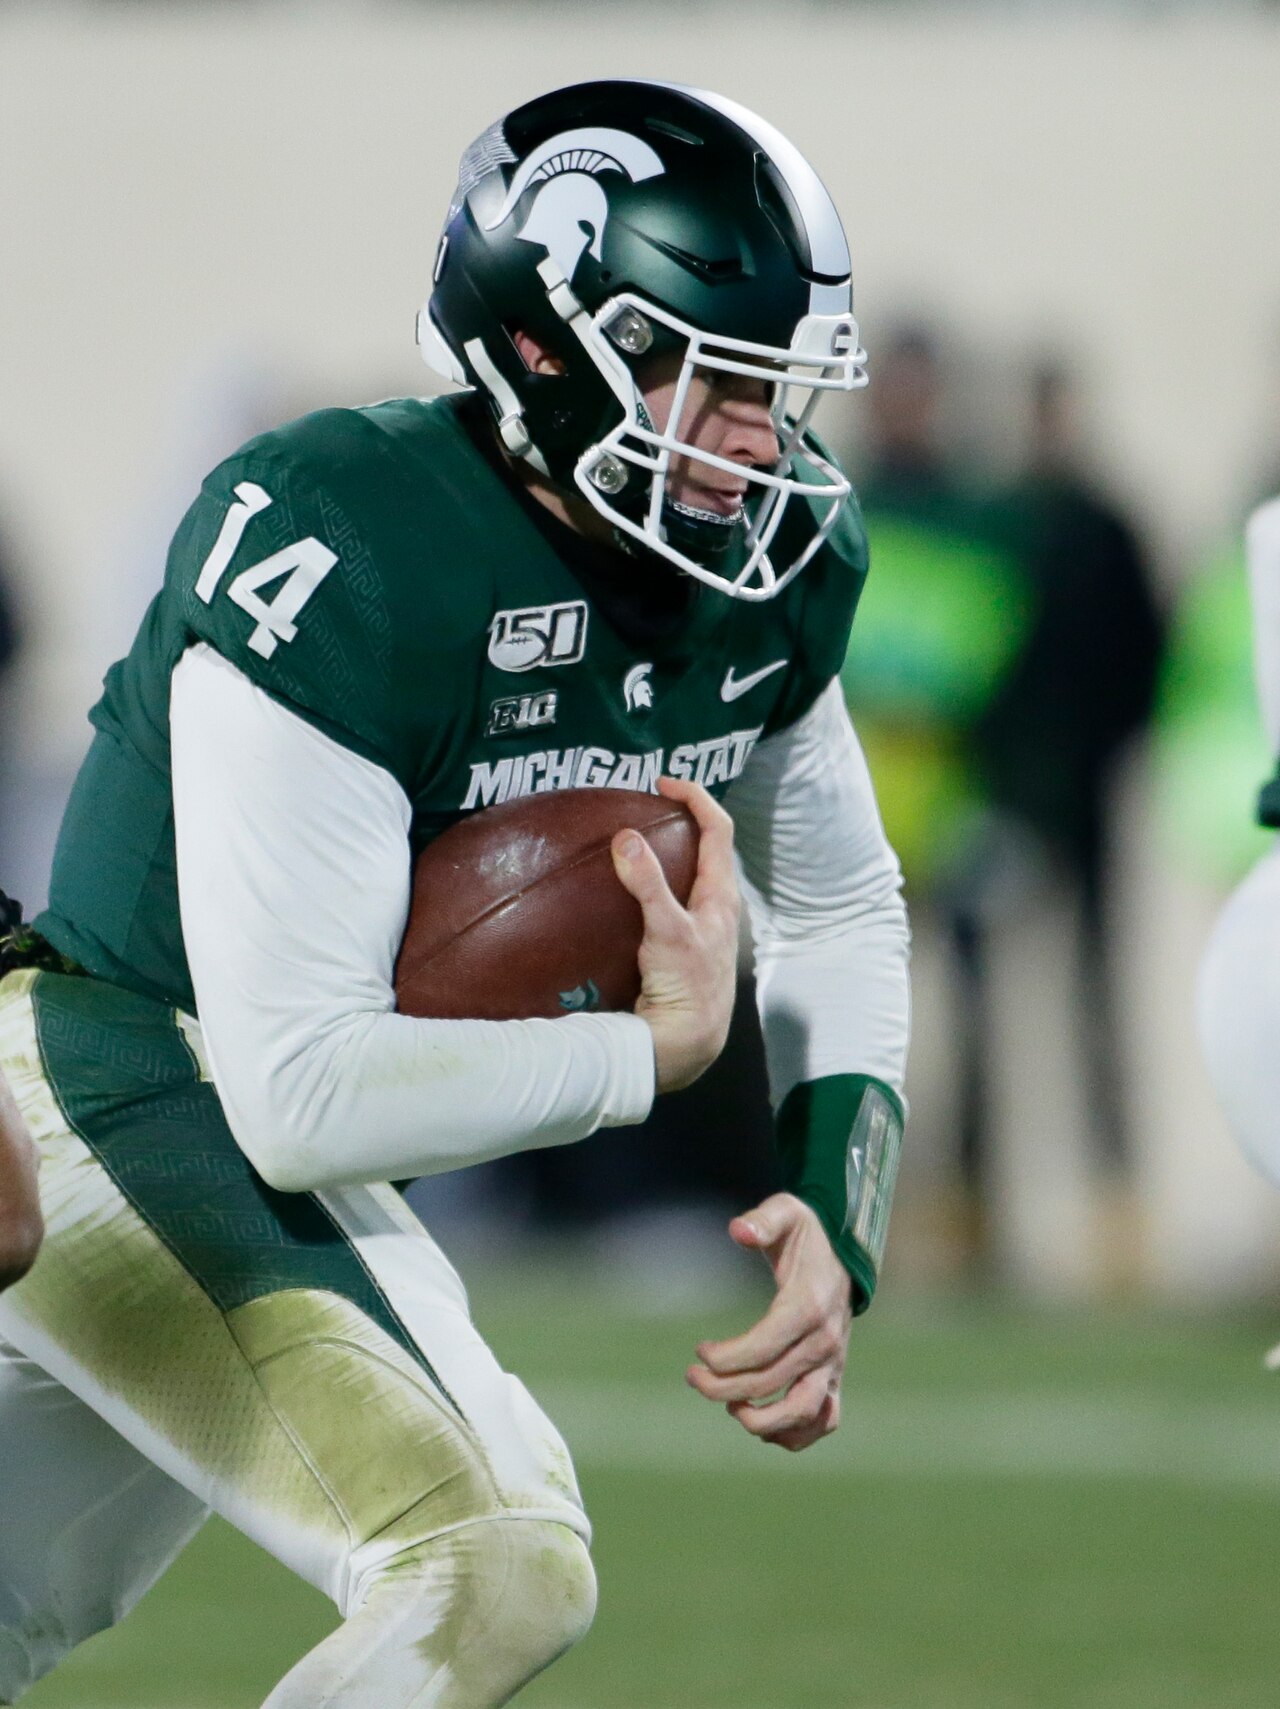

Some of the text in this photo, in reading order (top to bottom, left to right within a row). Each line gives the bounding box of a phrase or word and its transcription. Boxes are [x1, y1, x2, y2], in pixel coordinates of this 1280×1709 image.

[195, 481, 339, 660] 14
[488, 601, 587, 672] 150
[460, 724, 763, 810] MICHIGAN STAT
